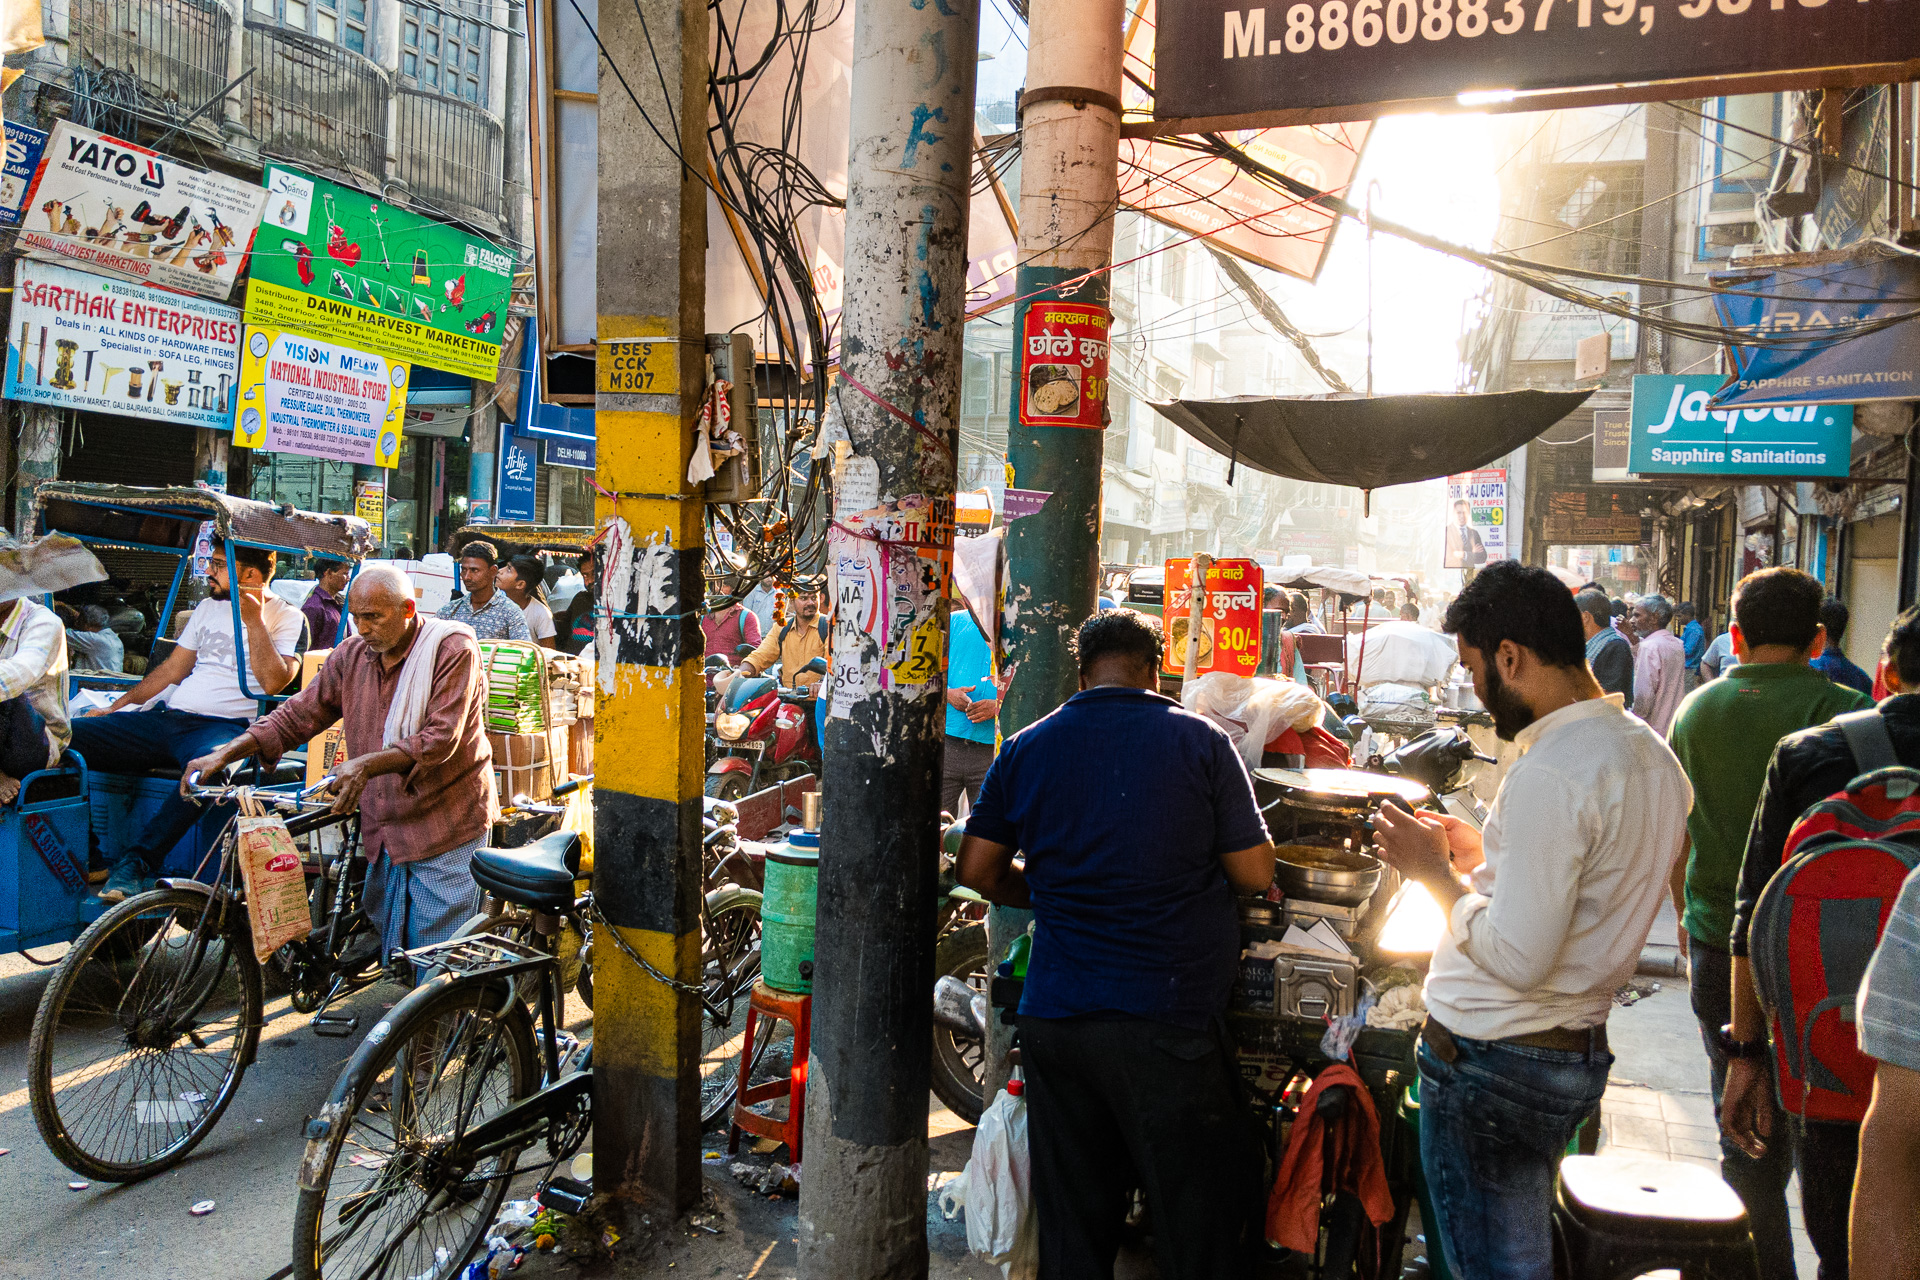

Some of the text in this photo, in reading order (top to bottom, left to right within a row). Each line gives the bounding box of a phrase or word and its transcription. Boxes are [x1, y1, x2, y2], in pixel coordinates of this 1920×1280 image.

[1224, 0, 1655, 59] M.8860883719,
[68, 136, 137, 177] YATO
[5, 163, 30, 176] LAMP
[61, 162, 160, 198] Best Cost Performance Tools from Europe
[177, 180, 256, 210] GARAGE TOOLS TOOLS
[202, 180, 251, 199] TOOLS TOOLS
[272, 175, 308, 197] Spanco
[177, 189, 250, 216] NON-SPARKING TOOLS TOOLS
[25, 233, 152, 276] DAWN HARVEST MARKETINGS
[480, 248, 512, 269] FALCON
[478, 263, 510, 278] Garden Tools
[22, 279, 116, 320] SARTHAK
[122, 302, 237, 345] ENTERPRISES
[112, 285, 147, 301] 8383819246,
[148, 293, 180, 307] 9810629281
[181, 300, 208, 315] (Landline)
[209, 307, 239, 320] 9318337275
[252, 315, 333, 339] www.dawnharvest.com
[254, 307, 275, 318] 3494,
[277, 313, 307, 325] Ground
[332, 327, 347, 336] Hira
[349, 331, 374, 343] Market,
[375, 337, 389, 346] Gali
[390, 341, 415, 353] Bajrang
[255, 286, 497, 356] Distributor DAWN HARVEST MARKETING
[255, 298, 276, 309] 3488,
[278, 303, 293, 313] 2nd
[295, 308, 318, 320] Floor,
[319, 314, 335, 323] Gali
[336, 318, 364, 332] Bajrang
[365, 326, 381, 336] Bali,
[382, 331, 406, 342] Chawri
[406, 337, 427, 348] Bazar,
[428, 342, 449, 353] Delhi-6
[450, 348, 460, 356] (M)
[1045, 312, 1090, 326] मक्खन
[55, 317, 235, 359] Deals in ALL KINDS OF HARDWARE ITEMS
[610, 343, 652, 356] BSES
[1028, 328, 1076, 357] छोले
[101, 339, 234, 371] Specialist in SOFA LEG, HINGES
[614, 357, 648, 371] CCK
[270, 360, 387, 402] NATIONAL INDUSTRIAL STORE
[610, 372, 655, 390] M307
[1739, 370, 1914, 391] SAPPHIRE SANITATION
[13, 386, 228, 425] 3481/1, SHOP NO. 11, SHIV MARKET, GALI BAJRANG BALI, CHAWRI BAZAR, DELHI-06
[288, 387, 367, 409] CERTIFIED AN ISO 9001 2005 CO.
[280, 397, 306, 413] PRESSURE
[325, 405, 336, 417] DIAL
[337, 407, 371, 424] THERMOMETER,
[270, 412, 377, 439] INDUSTRIAL THERMOMETER SS BALL VALVES
[272, 426, 284, 435] Mob.
[1603, 421, 1622, 429] True
[277, 438, 366, 459] E-mail nationalindustrialstore@gmail.com
[1651, 447, 1827, 466] Sapphire Sanitations
[1465, 483, 1504, 498] RAJ GUPTA
[1491, 507, 1503, 525] 9
[1222, 565, 1244, 580] वाले
[1212, 584, 1258, 620] कुल्चे
[916, 635, 927, 653] 7
[1218, 626, 1257, 651] 30/-
[911, 655, 926, 671] 2
[1237, 652, 1256, 666] प्लेट
